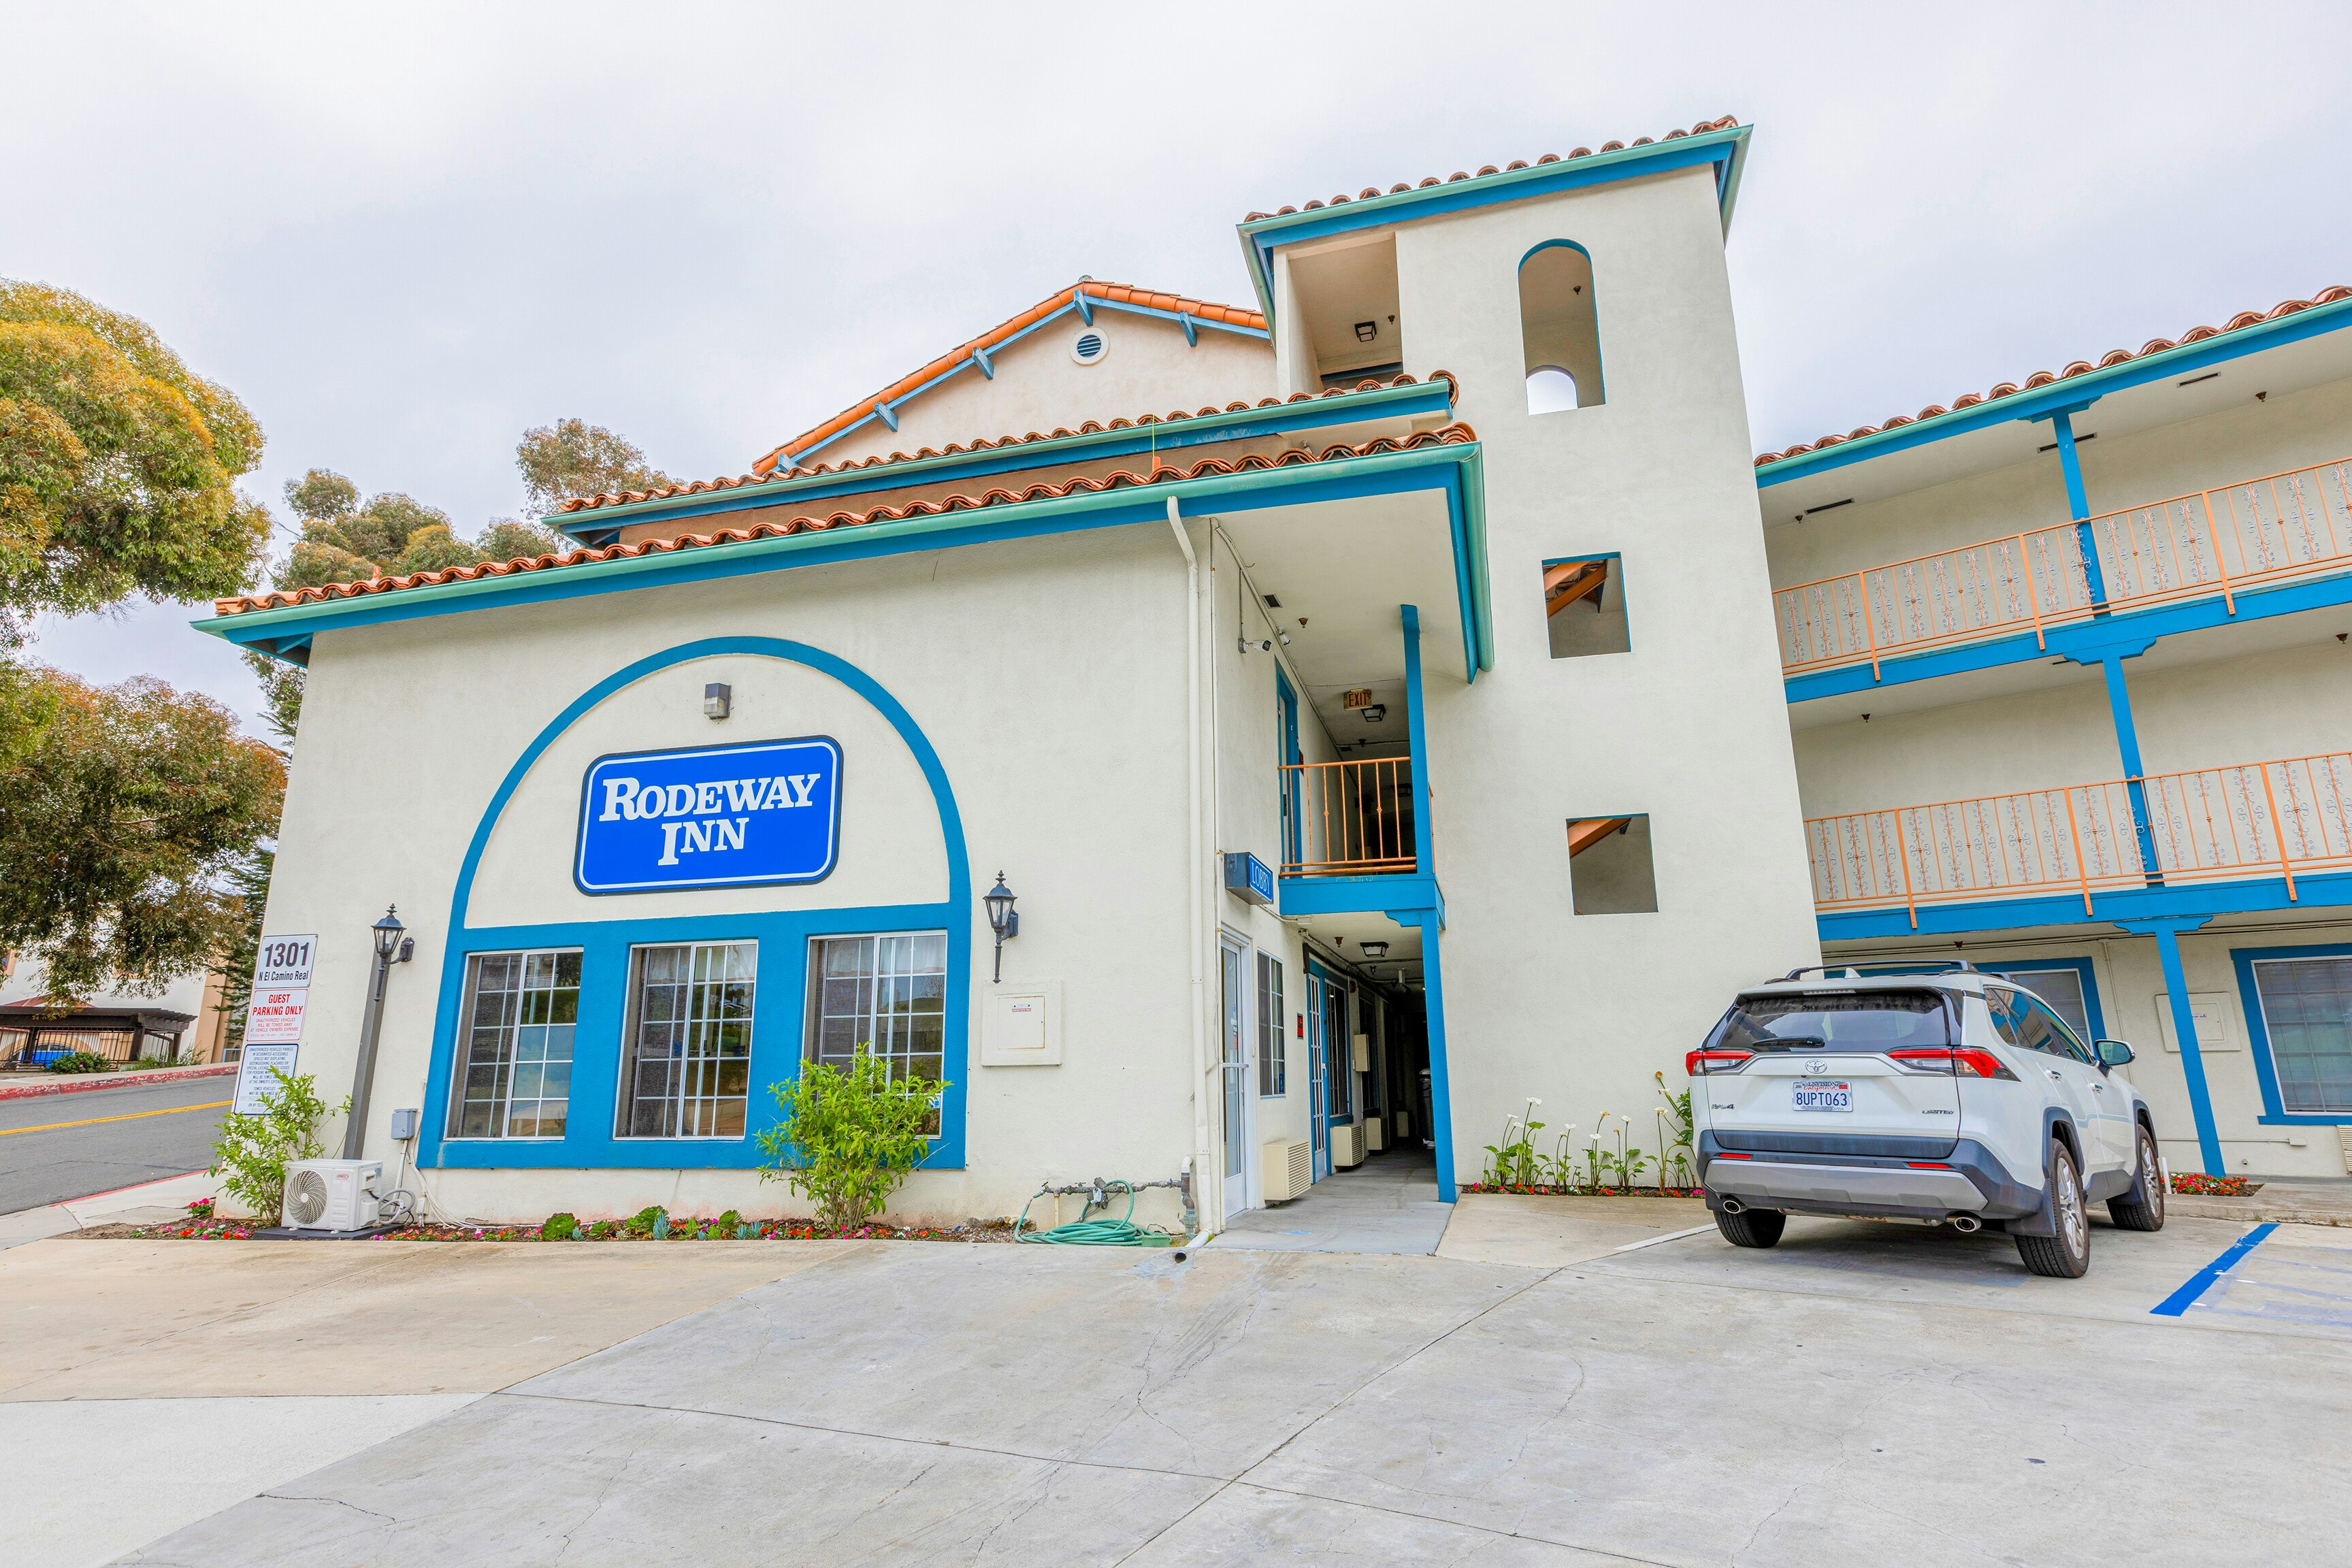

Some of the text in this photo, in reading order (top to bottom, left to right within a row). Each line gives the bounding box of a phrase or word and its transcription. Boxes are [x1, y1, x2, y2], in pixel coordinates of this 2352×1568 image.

[1348, 691, 1367, 707] EXIT
[657, 817, 749, 866] INN
[1251, 862, 1271, 895] LOBBY
[265, 942, 310, 968] 1301
[259, 970, 309, 981] N El Camino Real
[268, 994, 291, 1004] GUEST
[252, 1005, 304, 1016] PARKING ONLY
[1796, 1092, 1847, 1106] 8UPT063
